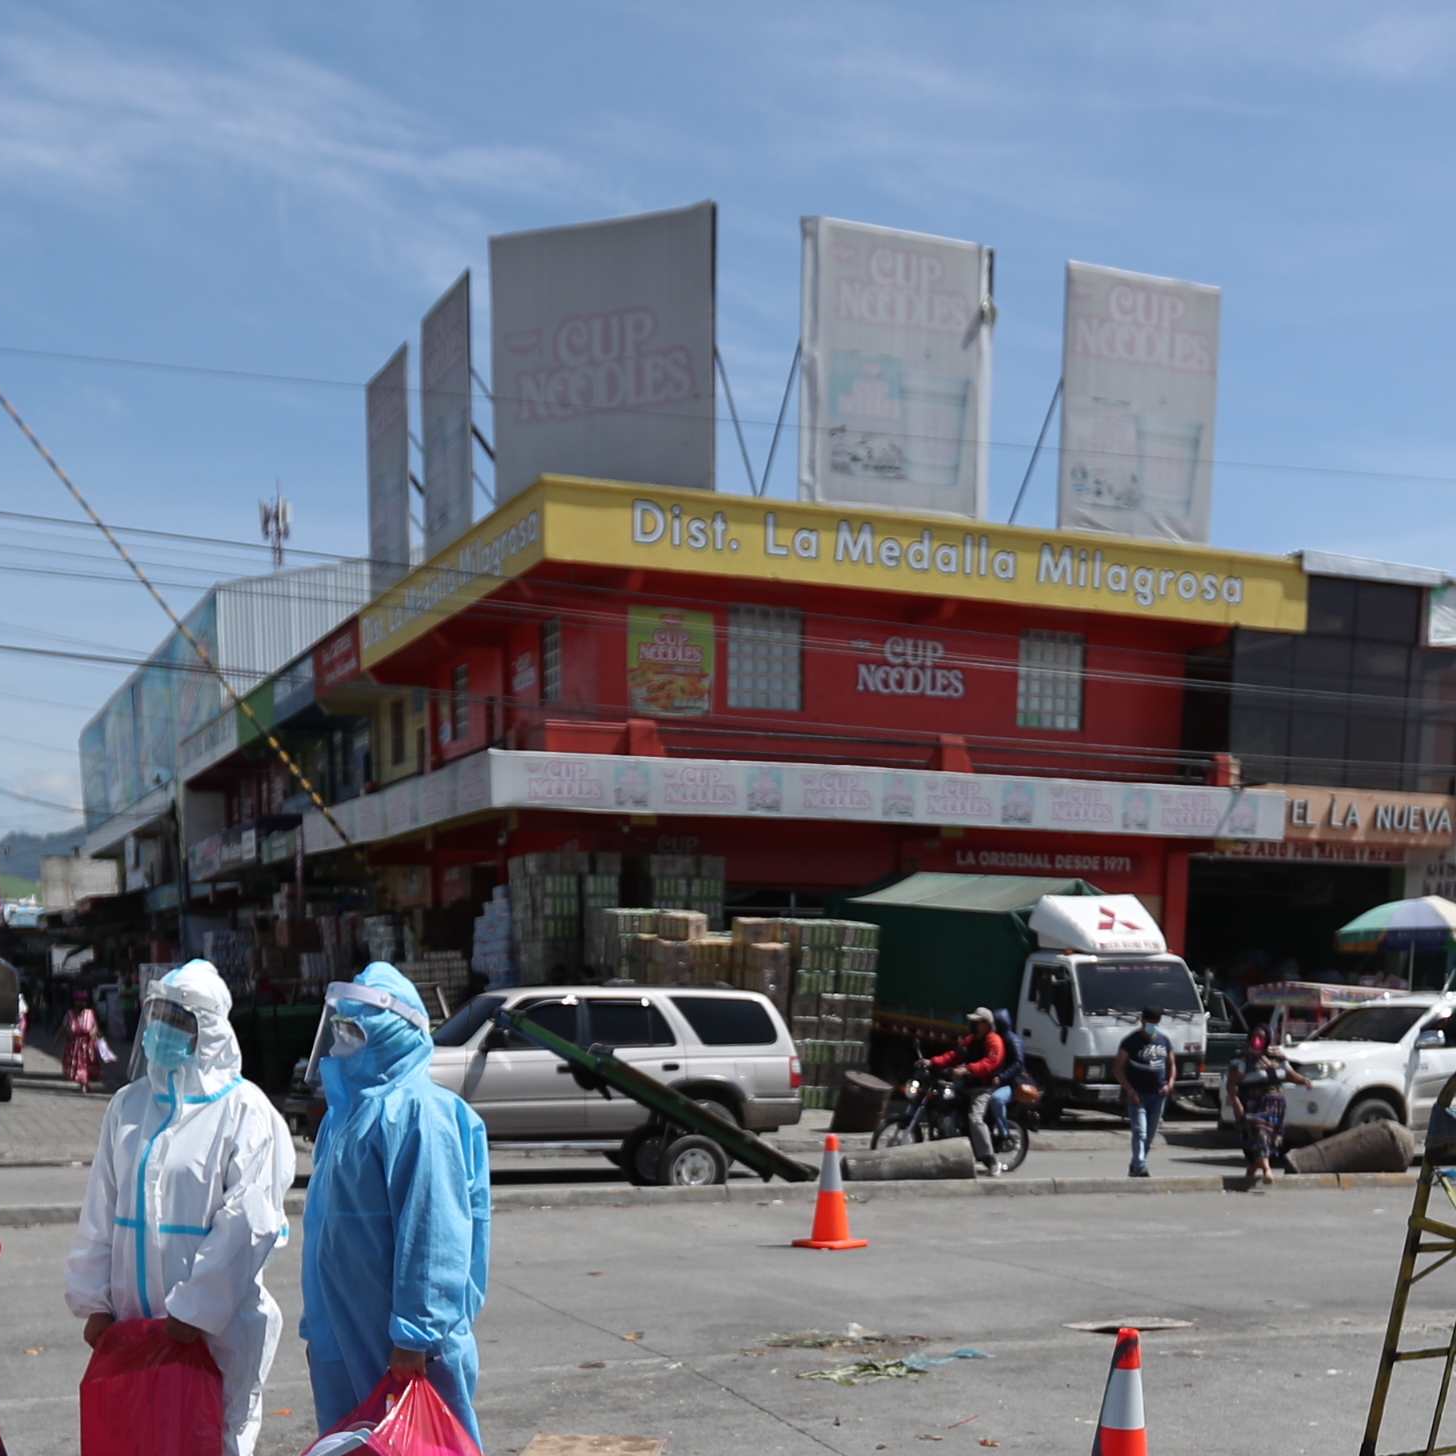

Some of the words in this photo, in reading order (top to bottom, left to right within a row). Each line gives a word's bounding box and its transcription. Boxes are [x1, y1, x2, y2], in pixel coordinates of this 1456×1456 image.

[869, 248, 944, 290] CUP
[837, 279, 972, 333] NOODLES
[1108, 284, 1186, 328] CUP
[556, 307, 657, 366] CUP
[1072, 316, 1212, 372] NOODLES
[516, 349, 693, 422] NOODLES
[631, 499, 740, 551] Dist.
[764, 511, 819, 560] La
[834, 519, 1018, 581] Medalla
[1037, 541, 1245, 607] Milagrosa
[388, 600, 404, 634] La
[404, 563, 457, 622] Medalla
[458, 509, 539, 587] Milagrosa
[653, 628, 689, 648] CUP
[883, 635, 946, 667] CUP
[638, 642, 703, 664] NOODLES
[855, 663, 966, 698] NOODLES
[546, 760, 589, 780] CUP
[680, 767, 722, 787] CUP
[818, 773, 861, 793] CUP
[529, 778, 604, 800] NOODLES
[664, 783, 737, 805] NOODLES
[803, 789, 874, 811] NOODLES
[944, 780, 980, 799] CUP
[1067, 786, 1103, 806] CUP
[1329, 799, 1362, 829] LA
[1375, 803, 1453, 833] NUEVA
[956, 849, 977, 867] LA
[978, 850, 1052, 869] ORIGINAL
[1054, 854, 1102, 872] DESDE
[1103, 856, 1132, 873] 1971
